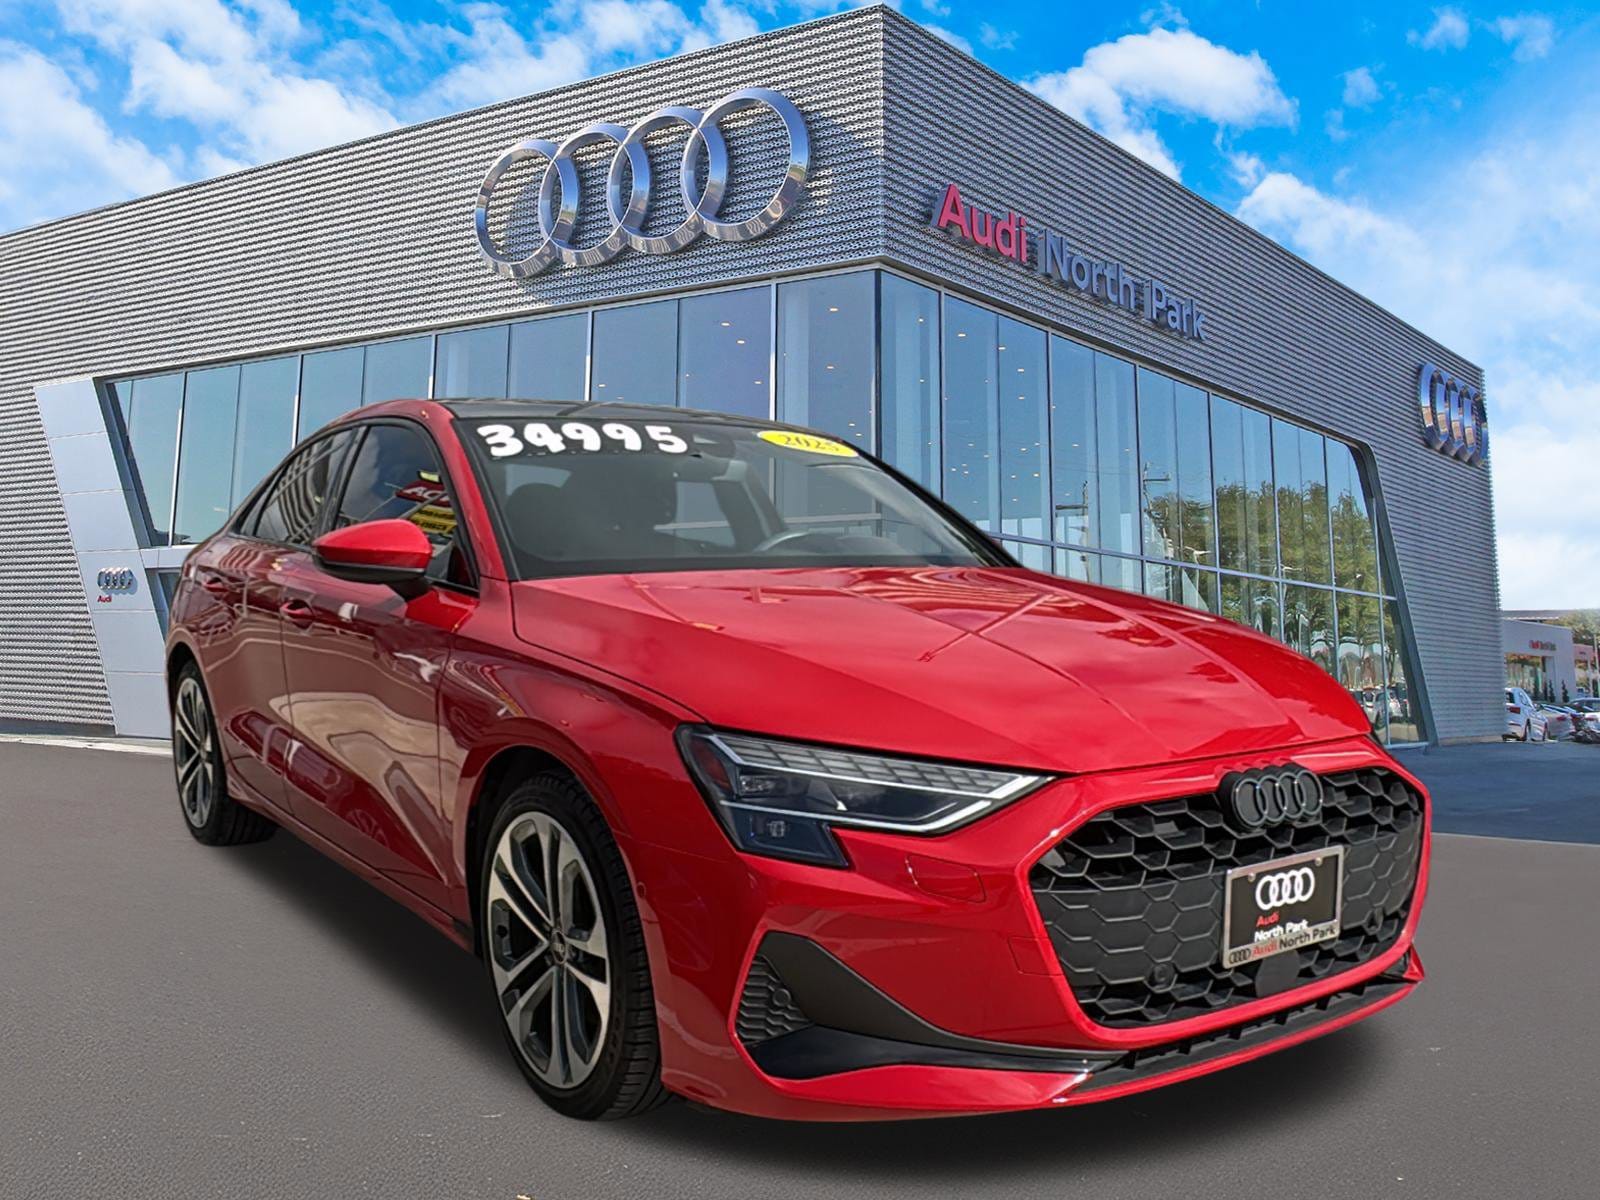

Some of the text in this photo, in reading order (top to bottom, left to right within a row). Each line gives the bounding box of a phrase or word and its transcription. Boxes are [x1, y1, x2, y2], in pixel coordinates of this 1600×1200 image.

[935, 183, 1208, 340] Audi North Park
[476, 423, 688, 457] 34995
[778, 434, 840, 452] 2025
[1256, 911, 1280, 927] Audi
[1285, 919, 1309, 935] Park
[1252, 925, 1335, 957] Audi North Park
